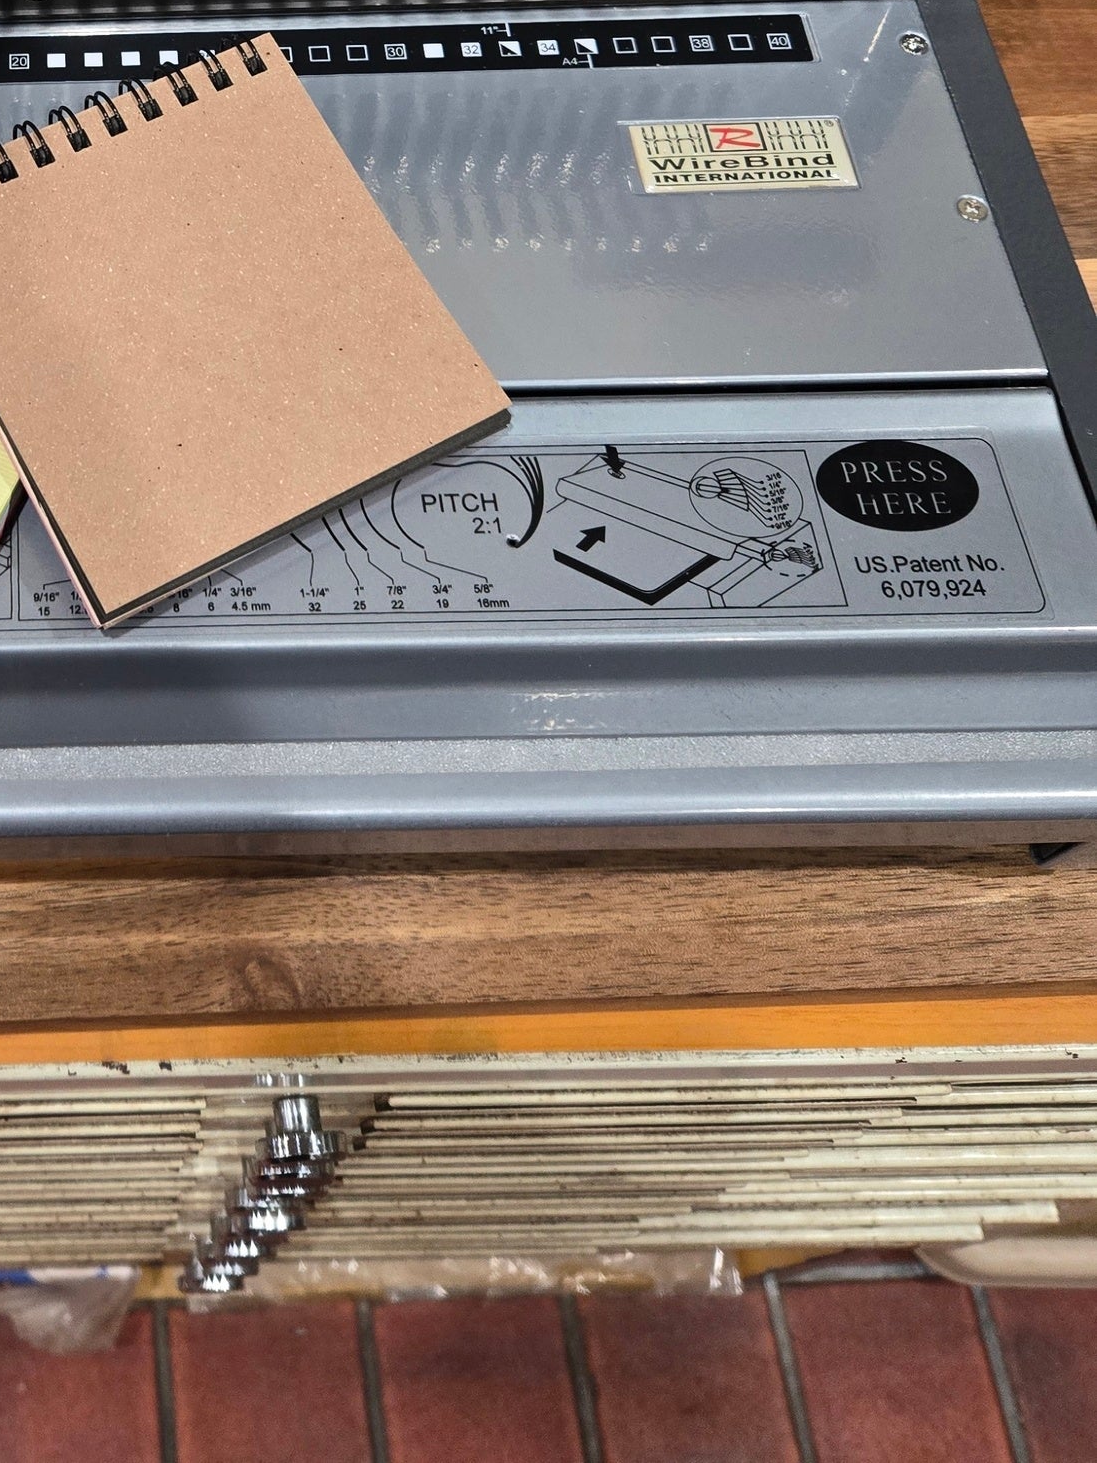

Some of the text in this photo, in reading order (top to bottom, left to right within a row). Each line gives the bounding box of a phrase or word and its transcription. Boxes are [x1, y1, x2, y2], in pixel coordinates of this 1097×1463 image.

[540, 42, 557, 53] 34
[692, 37, 711, 49] 38
[770, 36, 788, 48] 40
[387, 46, 405, 58] 30
[464, 44, 479, 55] 32
[12, 55, 29, 67] 20
[562, 56, 578, 66] A4
[649, 152, 834, 171] WireBind
[654, 169, 834, 183] INTERNATIONAL
[840, 460, 948, 484] PRESS
[421, 493, 499, 513] PITCH
[856, 492, 952, 516] HERE
[472, 518, 502, 534] 2:1
[855, 553, 1005, 574] US.Patent No.
[230, 587, 257, 597] 3/16"
[300, 588, 329, 598] 1-1/4"
[387, 585, 406, 596] 7/8"
[433, 584, 452, 595] 3/4"
[474, 584, 493, 594] 5/8"
[881, 580, 987, 600] 6,079,924
[33, 592, 60, 602] 9/16"
[173, 602, 180, 613] 8
[232, 602, 271, 611] 4.5 mm
[308, 603, 322, 612] 32
[353, 601, 366, 610] 25
[391, 600, 404, 610] 22
[436, 599, 449, 608] 19
[38, 607, 51, 616] 15
